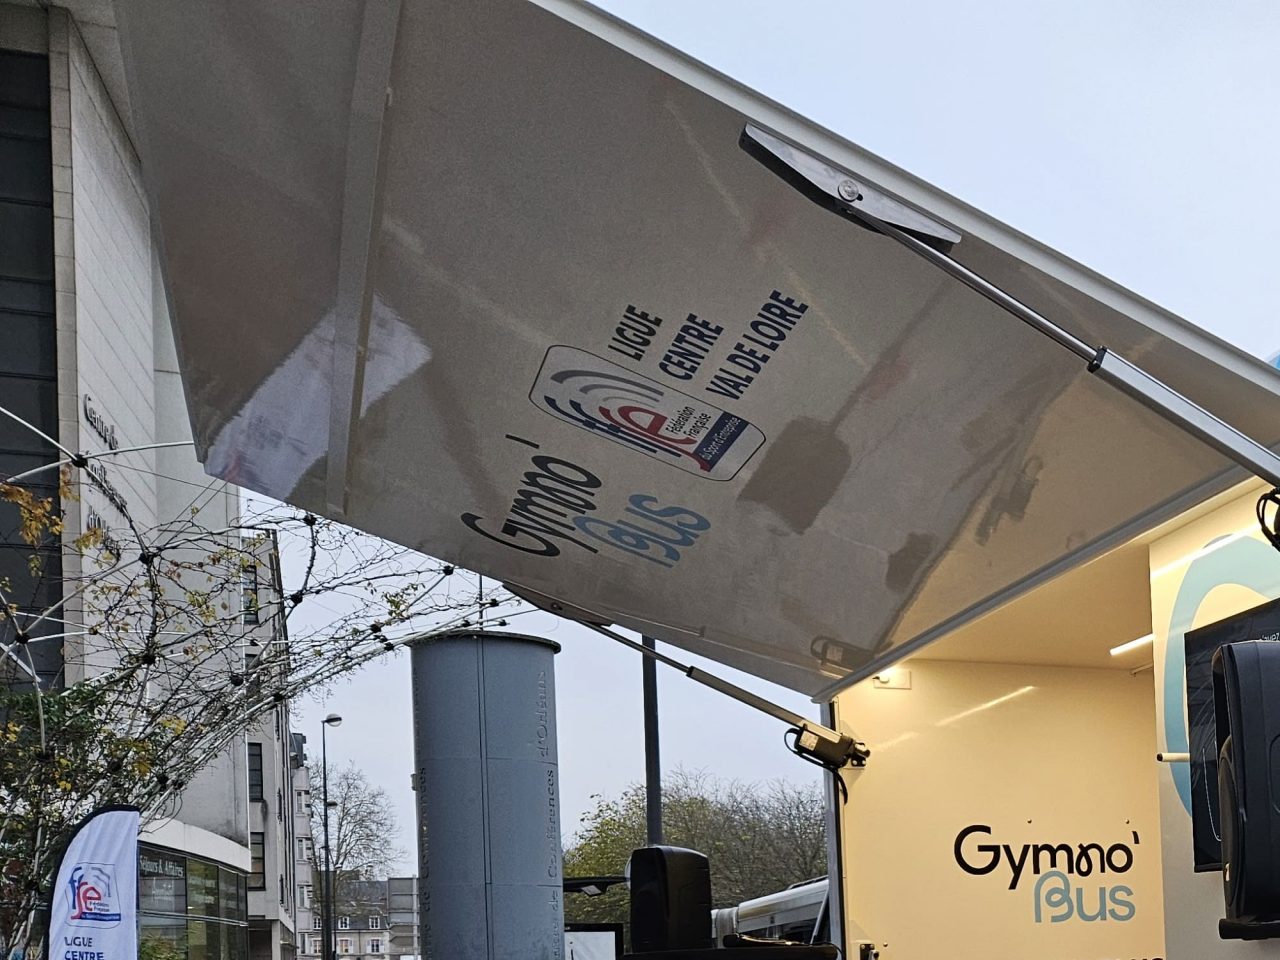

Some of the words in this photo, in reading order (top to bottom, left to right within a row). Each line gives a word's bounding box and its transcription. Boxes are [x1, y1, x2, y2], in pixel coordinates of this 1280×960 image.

[608, 304, 662, 361] LIGUE
[742, 290, 809, 352] LOIRE
[659, 313, 724, 381] CENTRE
[726, 342, 770, 374] DE
[705, 368, 754, 400] VAL
[665, 405, 696, 435] Fédération
[683, 413, 711, 438] Française
[1034, 870, 1136, 923] Bus
[64, 937, 93, 947] LIGUE
[64, 951, 105, 960] CENTRE
